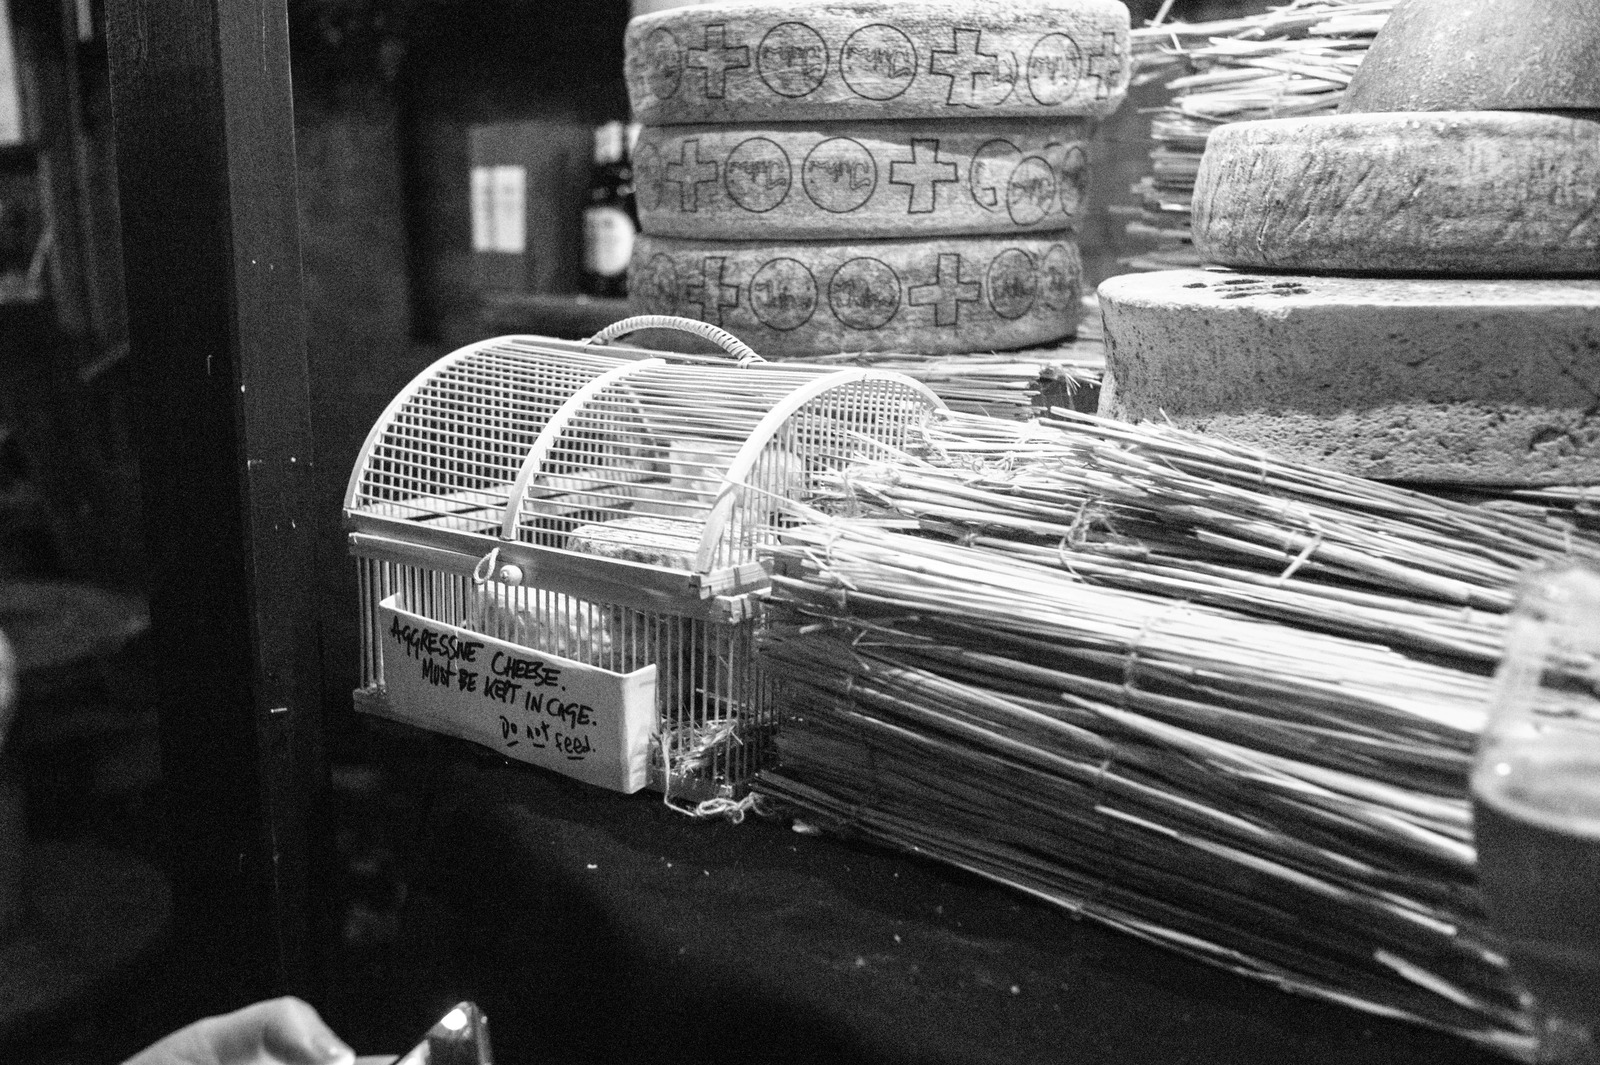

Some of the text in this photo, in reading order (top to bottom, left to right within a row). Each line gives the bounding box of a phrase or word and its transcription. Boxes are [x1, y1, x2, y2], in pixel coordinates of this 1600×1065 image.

[491, 651, 566, 692] CHEESE.
[458, 669, 479, 692] BE
[525, 691, 544, 713] IN
[546, 698, 597, 730] CAGE.
